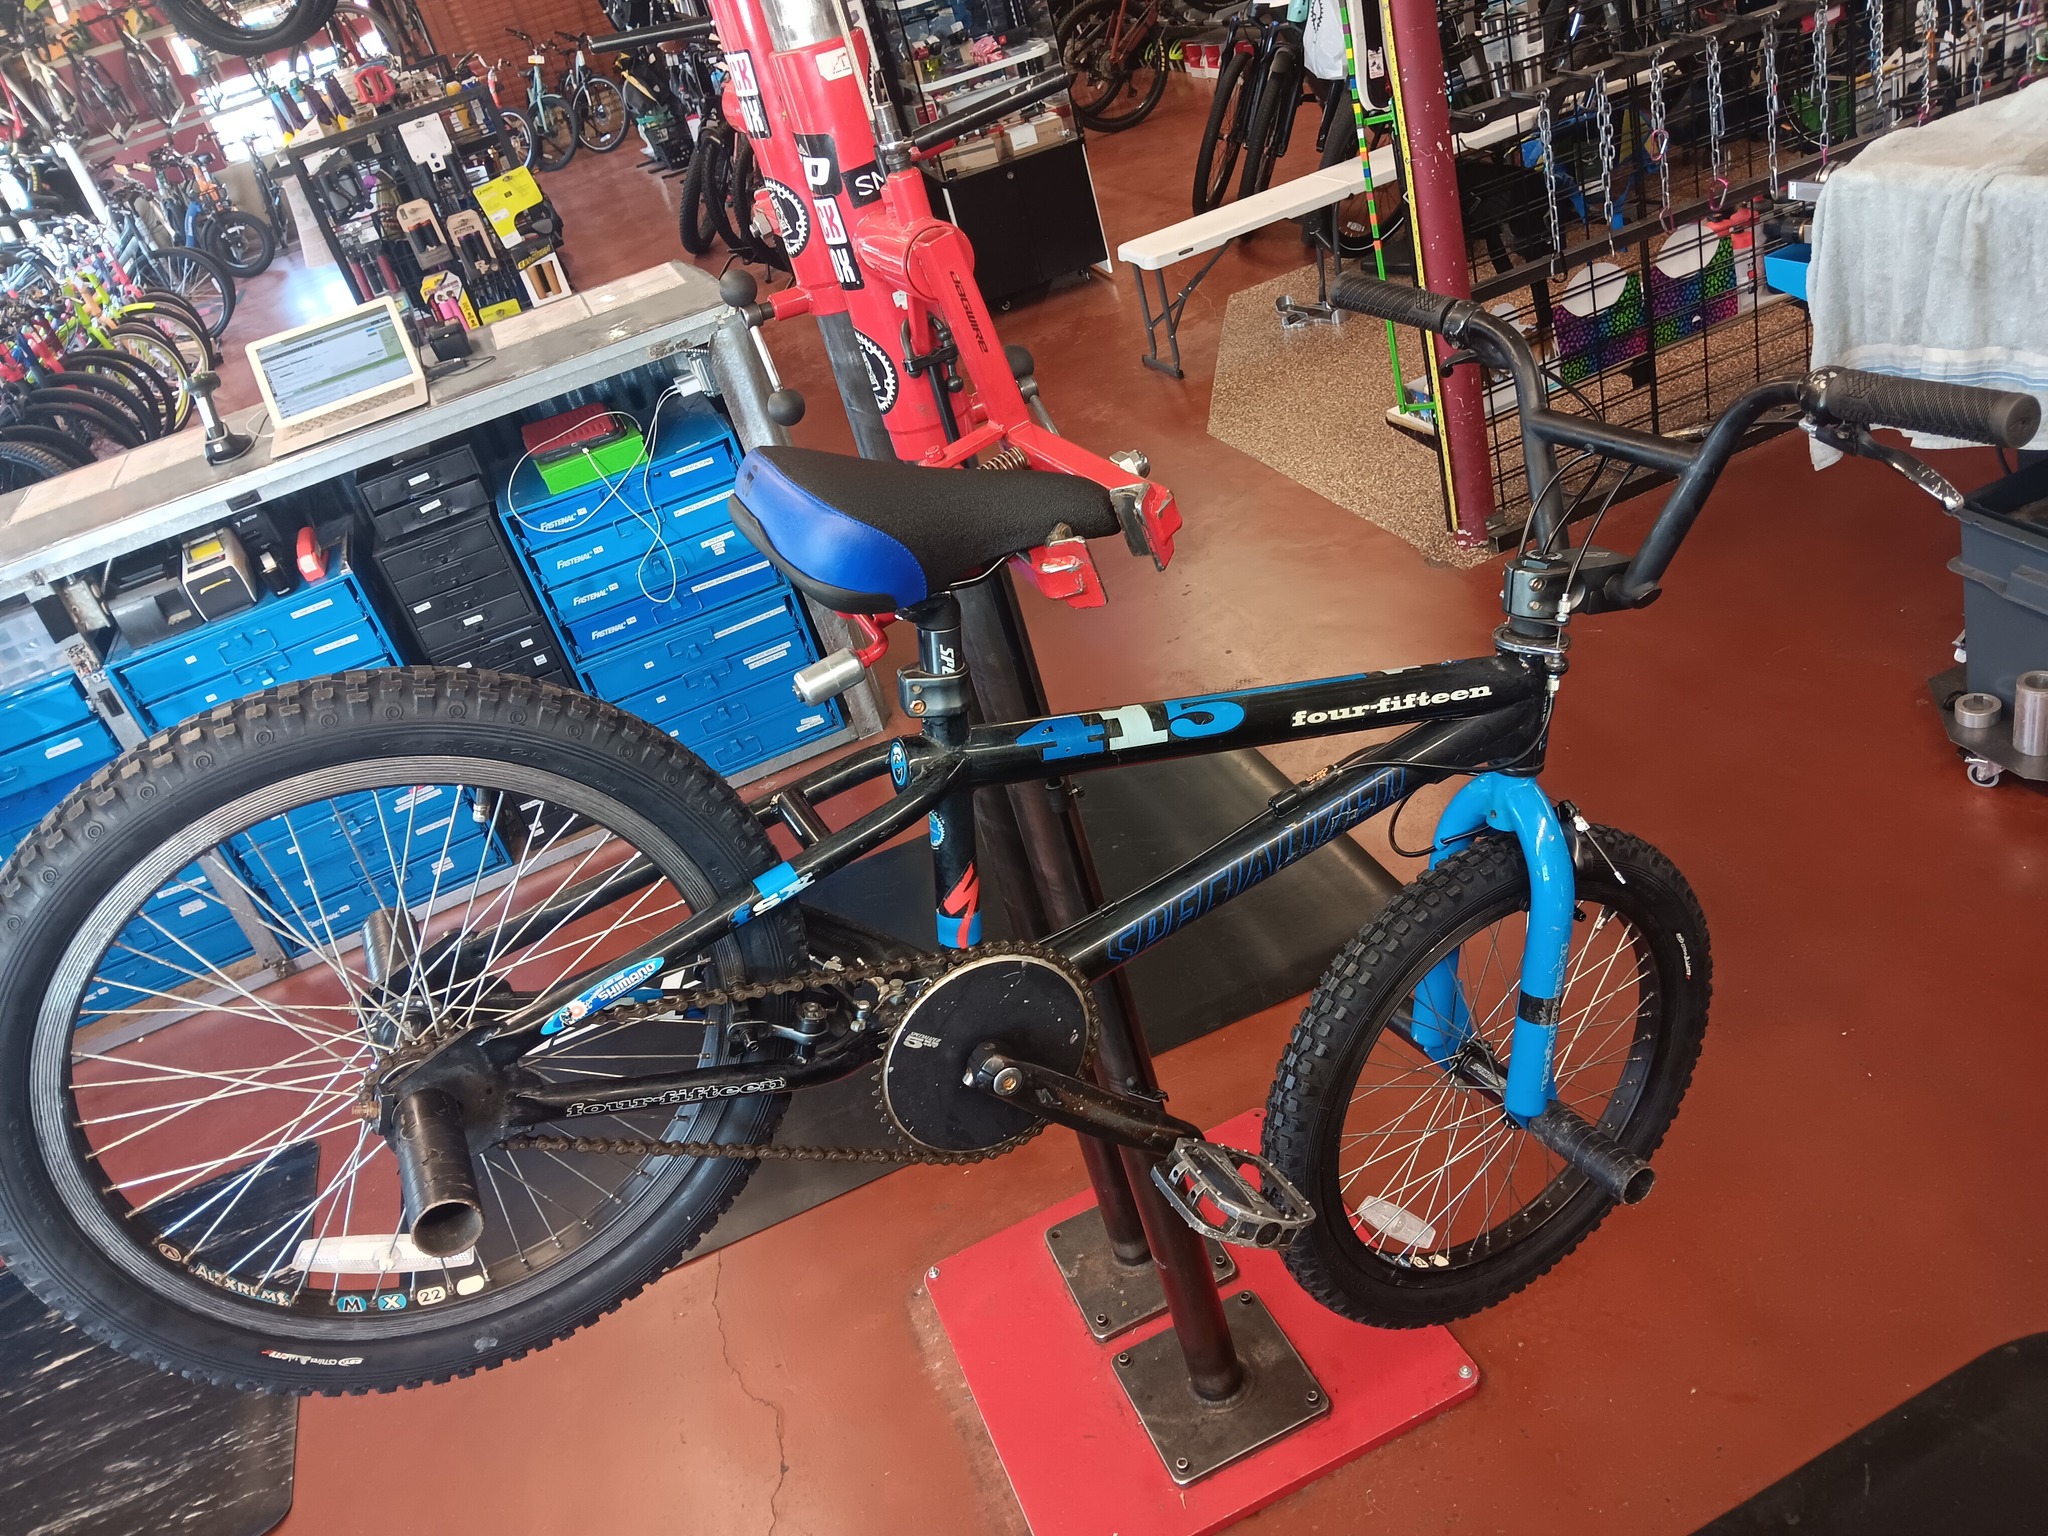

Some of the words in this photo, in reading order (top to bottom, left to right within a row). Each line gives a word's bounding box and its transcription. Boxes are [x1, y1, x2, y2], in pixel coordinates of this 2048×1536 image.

[538, 511, 576, 532] FASTENAL
[555, 550, 592, 570] FASTENAL
[571, 587, 608, 606] FASTENAL
[590, 621, 626, 640] FASTENAL
[1292, 685, 1492, 727] four-fifteen
[1016, 701, 1245, 762] 415
[596, 961, 657, 1002] SHIMANO
[565, 1076, 788, 1117] four-fifteen
